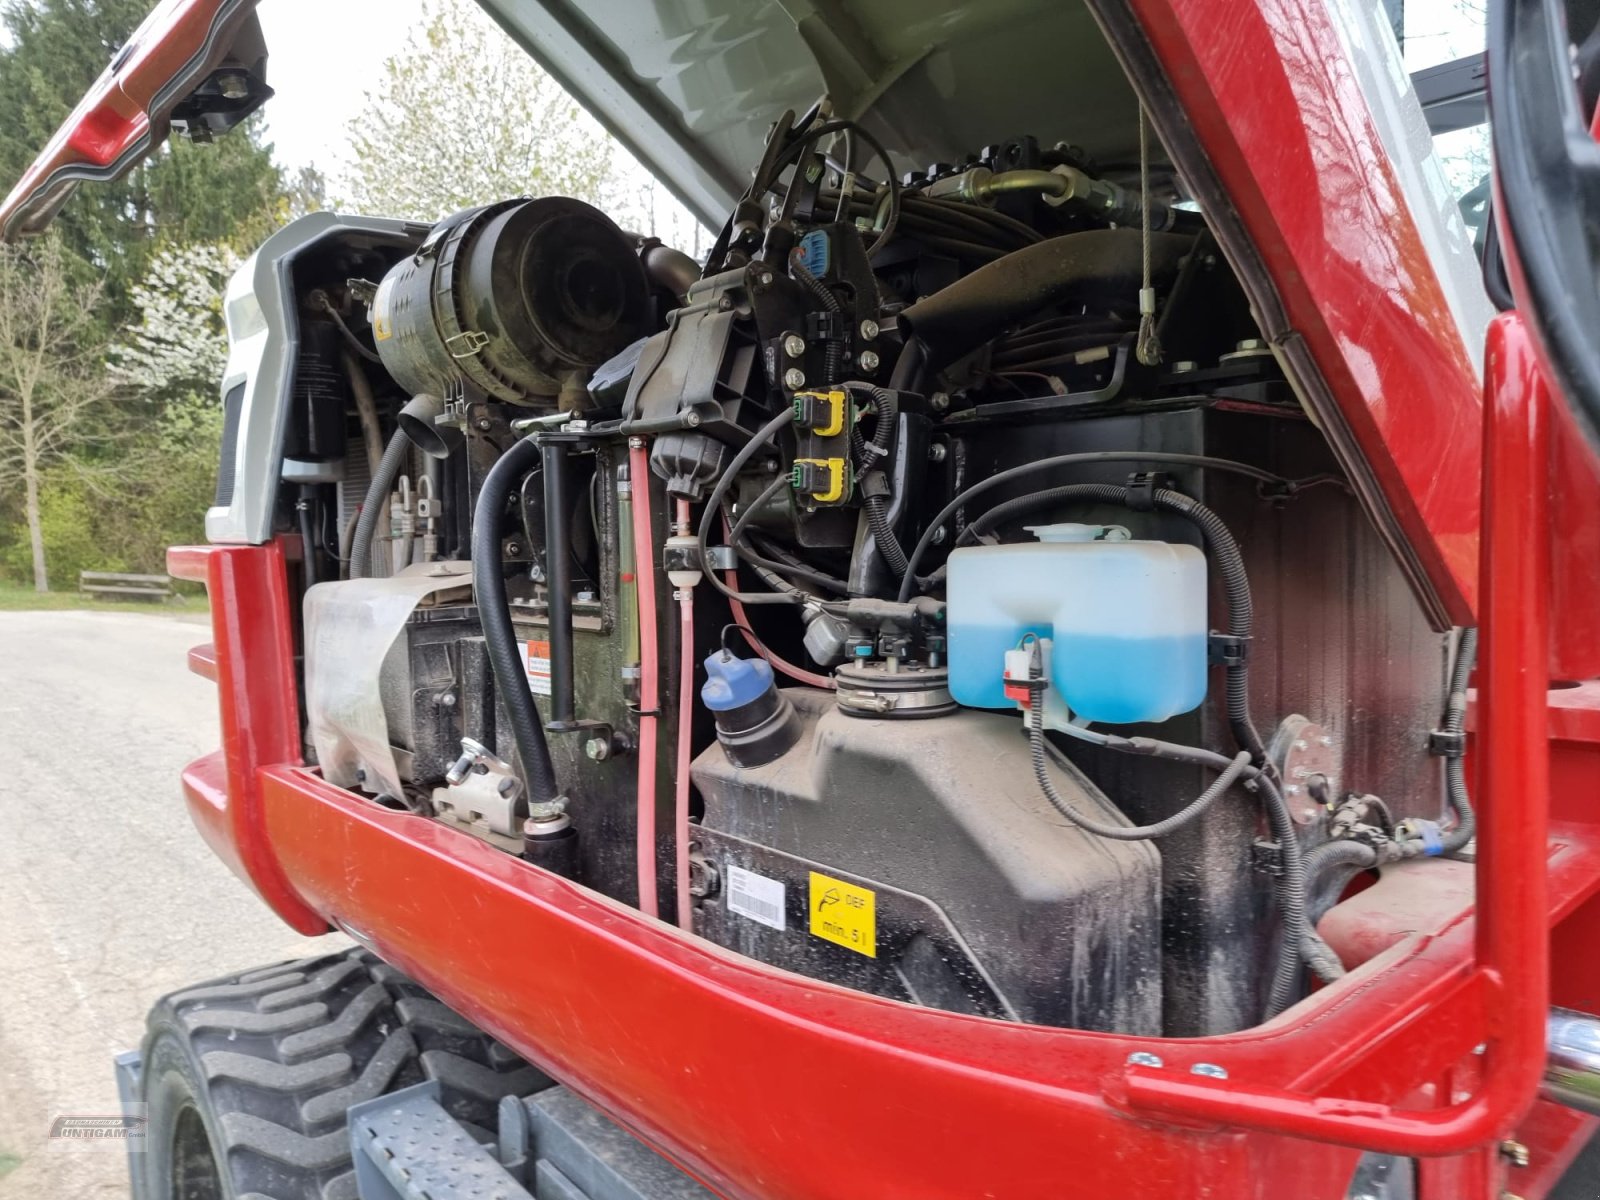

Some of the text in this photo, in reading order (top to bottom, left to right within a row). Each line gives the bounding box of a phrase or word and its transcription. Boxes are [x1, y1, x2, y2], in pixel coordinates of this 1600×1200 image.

[846, 894, 865, 910] DEF
[822, 921, 848, 939] min.
[852, 928, 859, 943] 5
